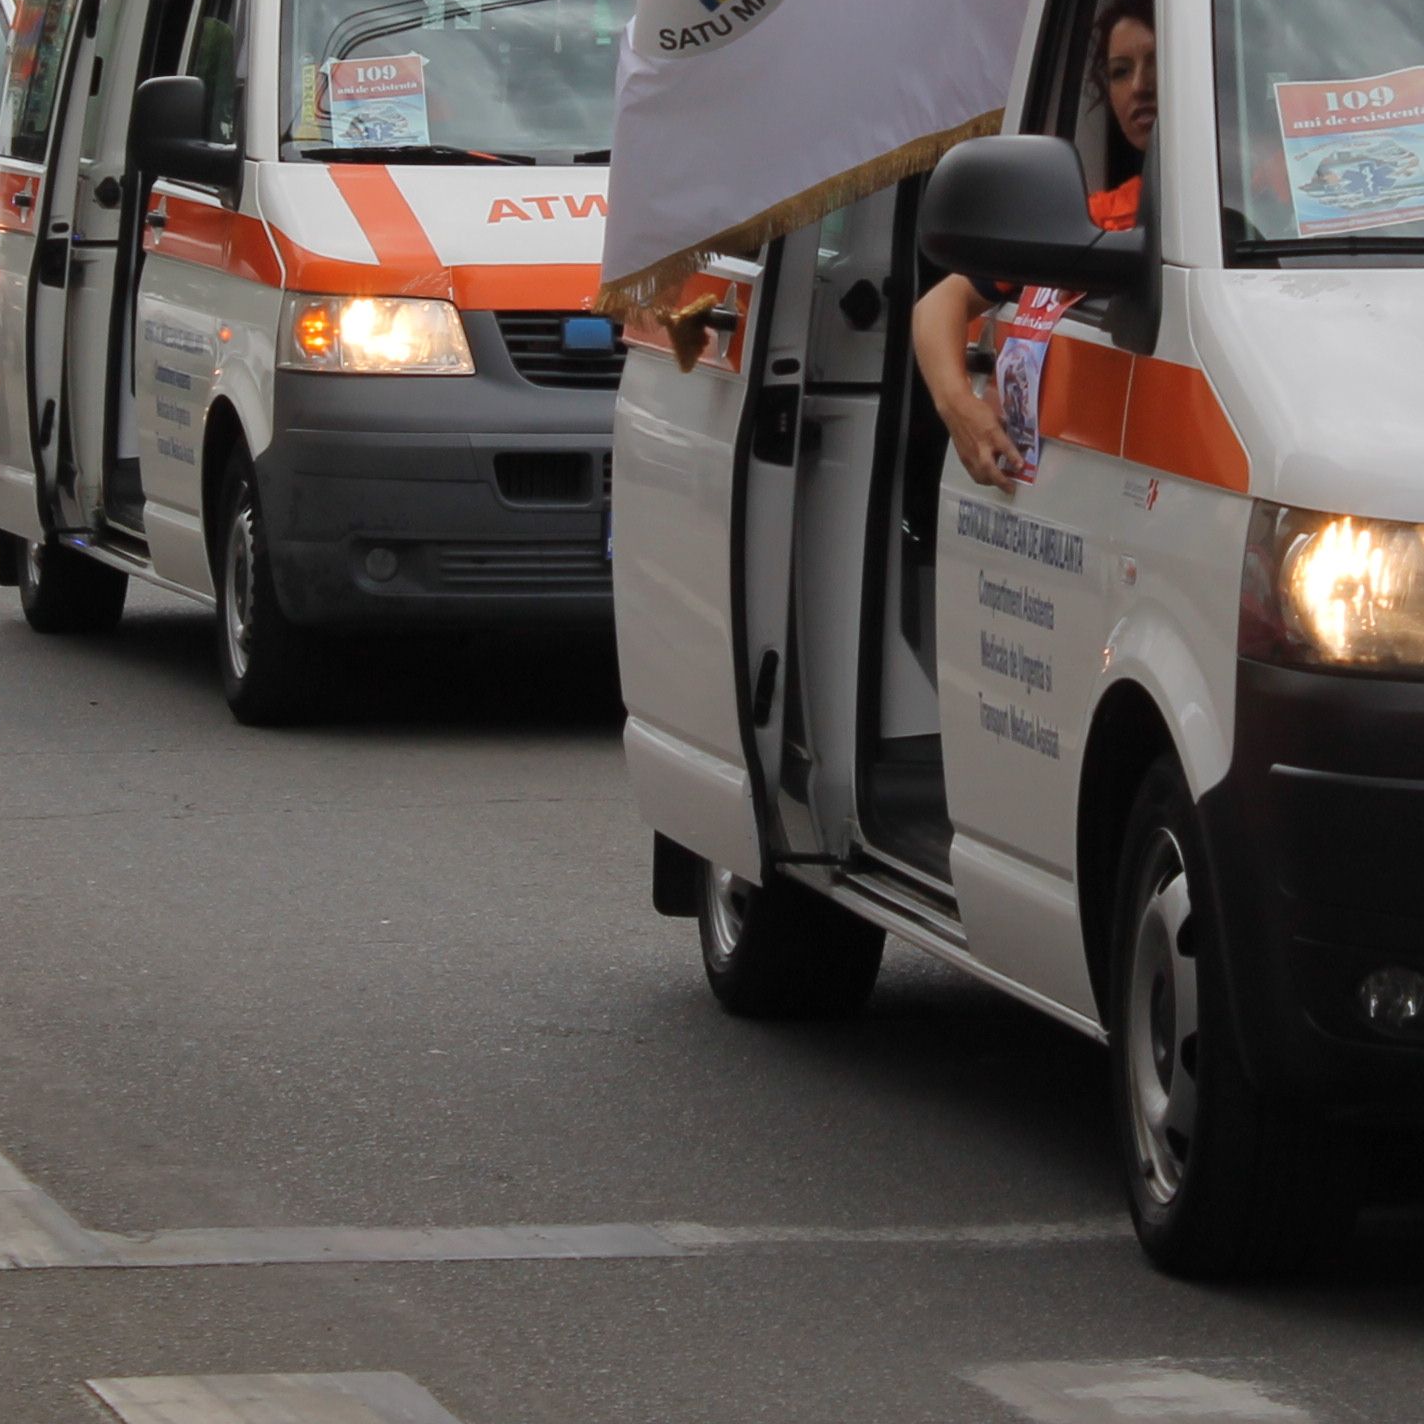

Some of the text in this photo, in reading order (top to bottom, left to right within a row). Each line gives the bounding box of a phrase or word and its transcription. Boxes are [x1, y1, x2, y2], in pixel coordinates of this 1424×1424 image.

[659, 13, 733, 52] SATU
[356, 64, 397, 83] 109
[1325, 86, 1395, 112] 109
[1293, 117, 1322, 129] ani
[1325, 115, 1347, 126] de
